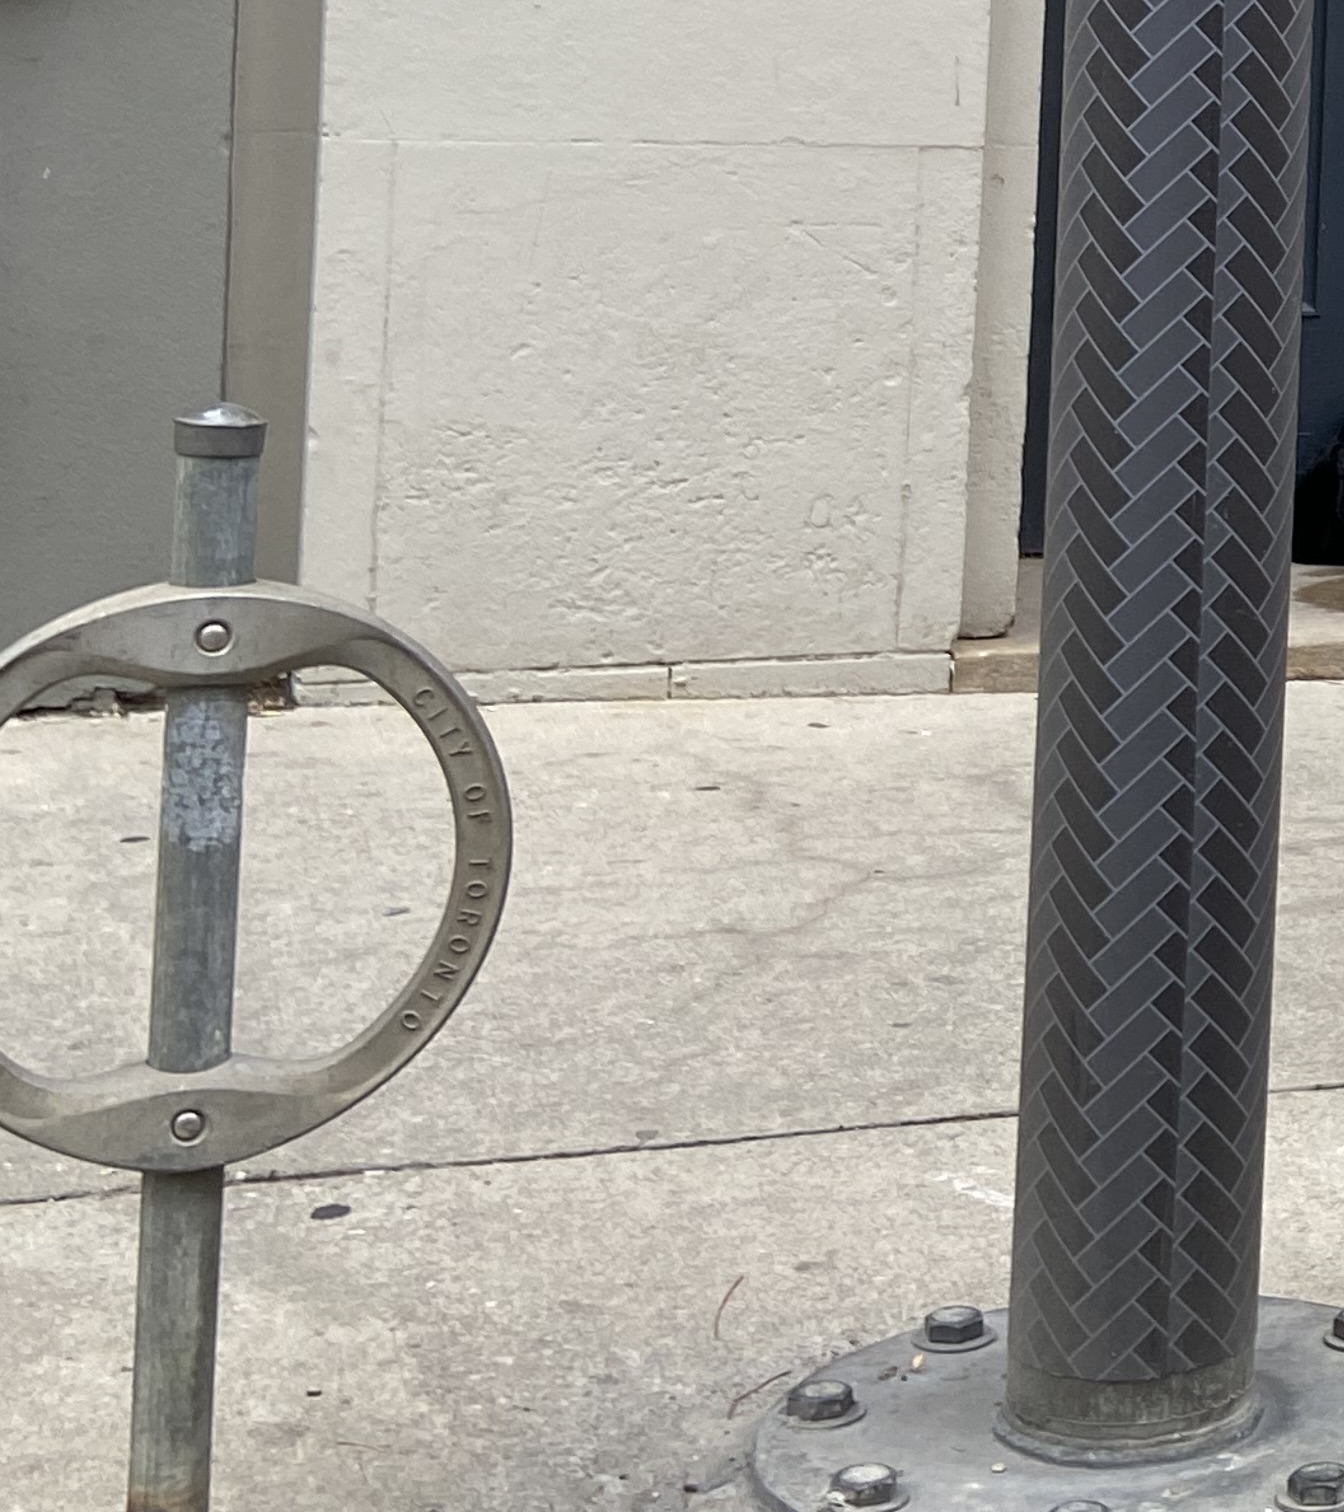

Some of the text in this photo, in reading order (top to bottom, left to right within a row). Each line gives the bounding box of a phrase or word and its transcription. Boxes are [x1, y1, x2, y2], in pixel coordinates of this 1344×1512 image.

[401, 687, 496, 1031] CITY OF TORONTO
